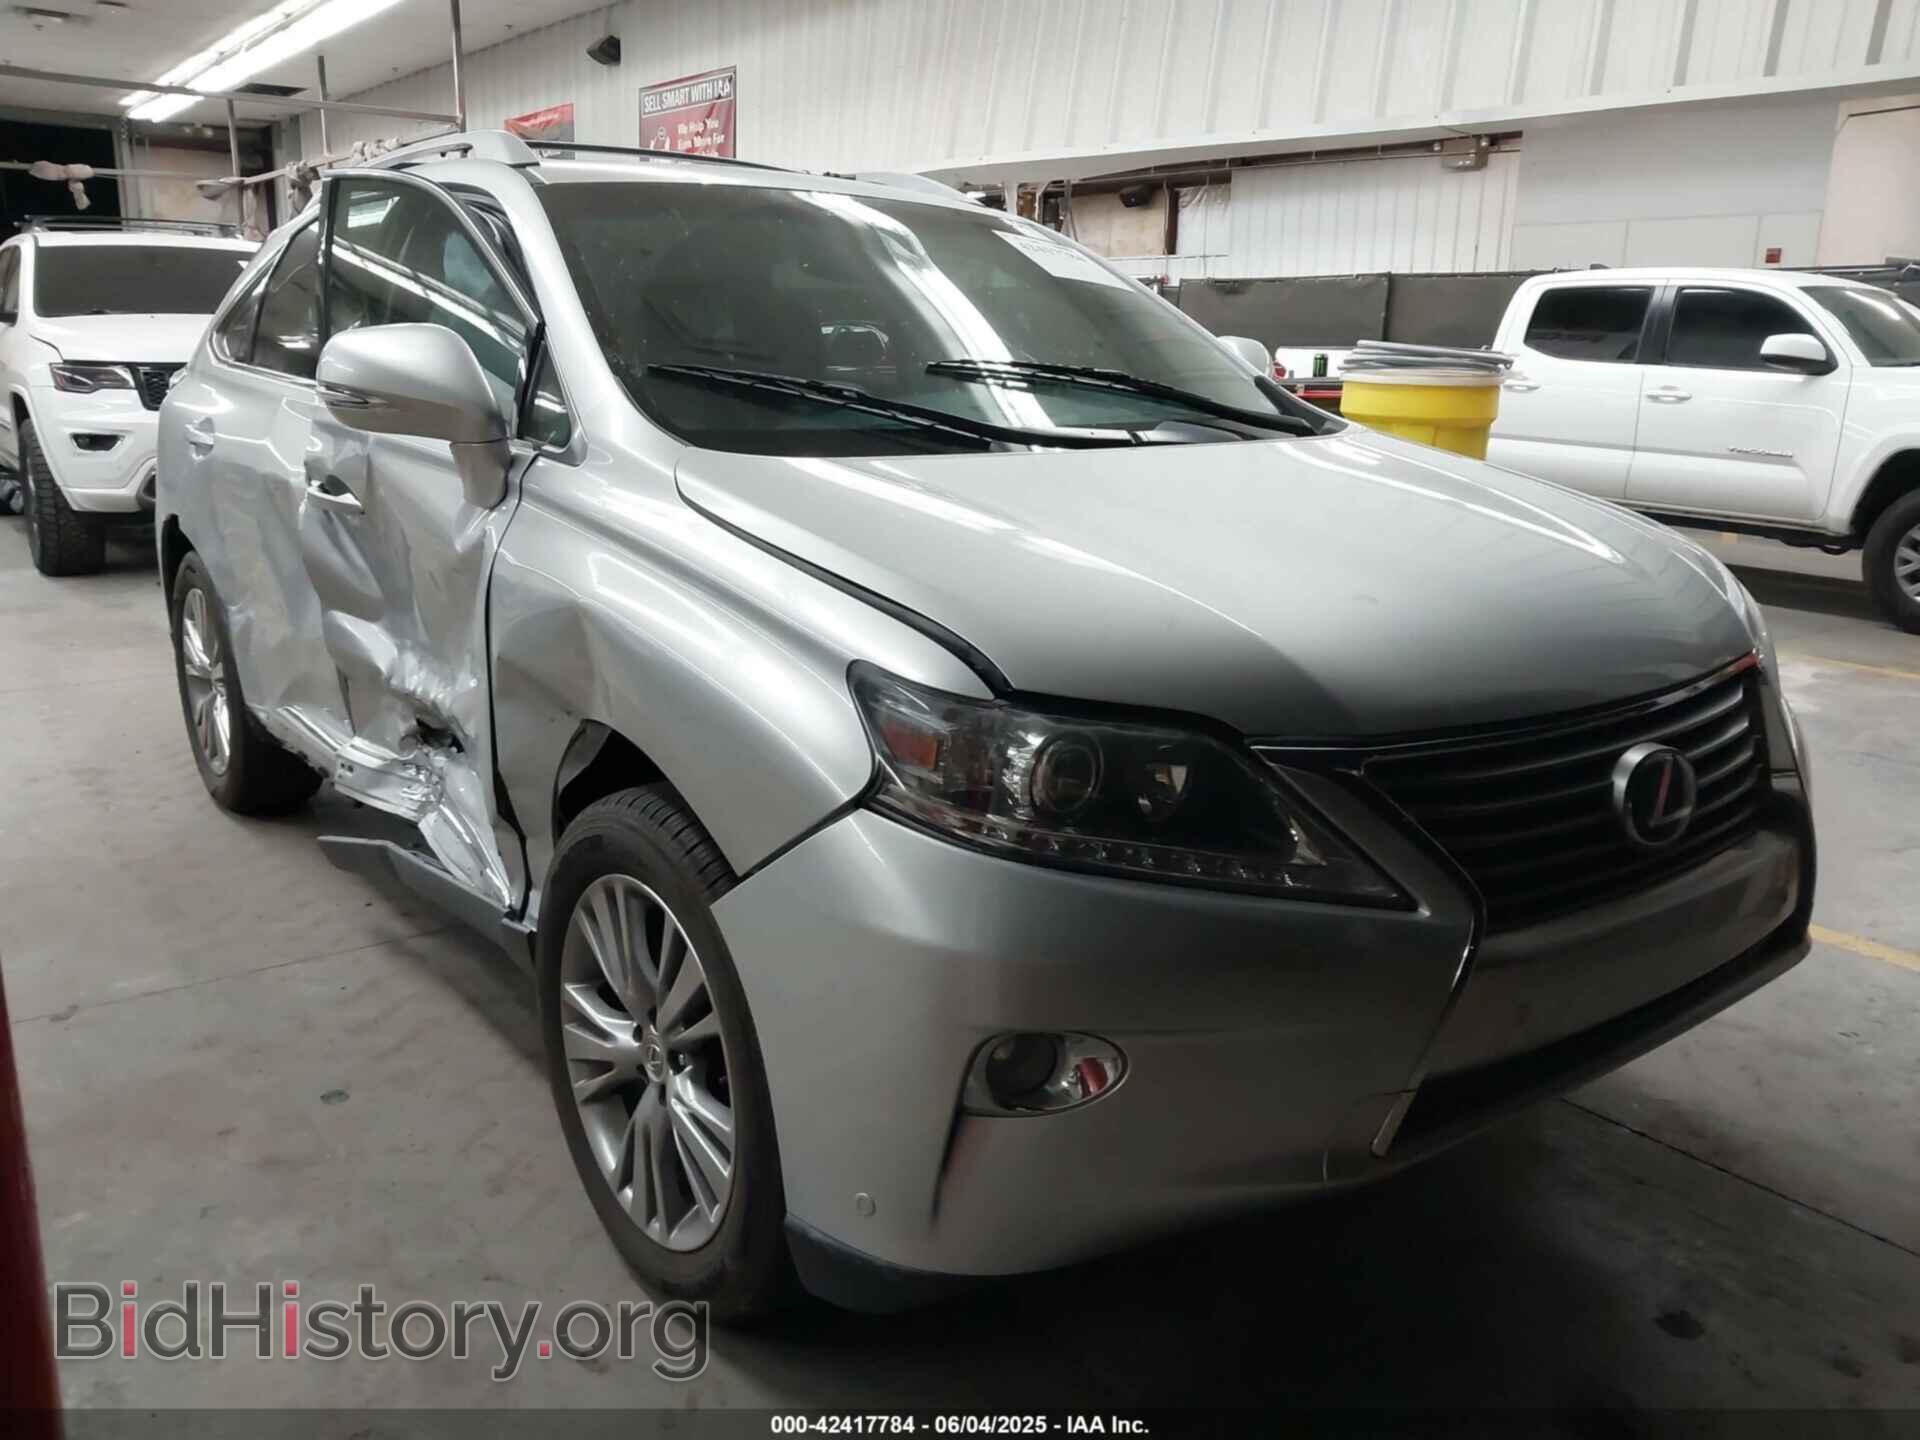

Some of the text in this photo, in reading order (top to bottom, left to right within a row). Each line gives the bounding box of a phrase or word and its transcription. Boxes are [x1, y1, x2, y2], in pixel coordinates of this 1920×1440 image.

[643, 92, 662, 113] SELL
[661, 87, 690, 109] SMART
[690, 80, 713, 103] WITH
[704, 117, 720, 130] You
[712, 131, 726, 144] For
